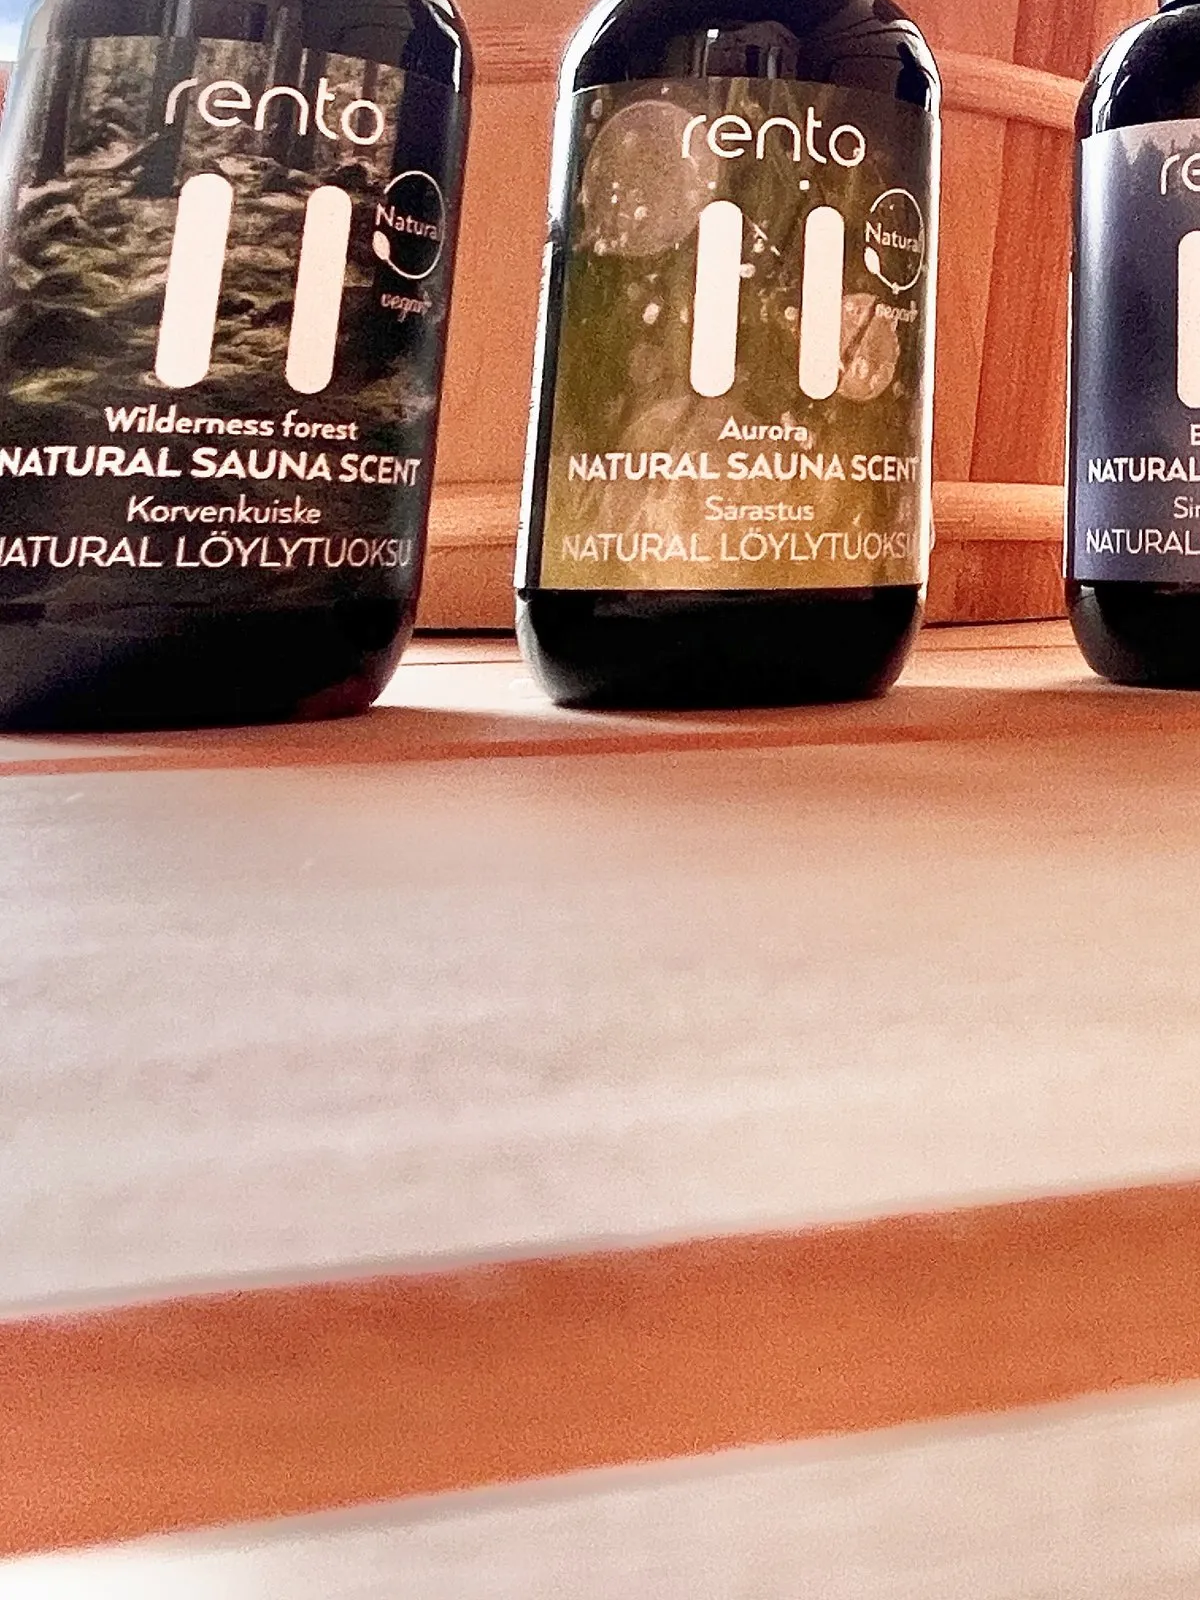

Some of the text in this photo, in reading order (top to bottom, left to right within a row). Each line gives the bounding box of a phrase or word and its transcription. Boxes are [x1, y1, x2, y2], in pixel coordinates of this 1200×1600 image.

[166, 77, 385, 146] rento
[682, 107, 867, 168] rento
[104, 404, 360, 441] Wilderness forest
[717, 415, 809, 442] Aurora
[0, 445, 422, 487] NATURAL SAUNA SCENT
[569, 452, 919, 483] NATURAL SAUNA SCENT
[127, 494, 322, 524] Korvenkuiske
[704, 495, 815, 521] Sarastus
[176, 530, 412, 568] LÖYLYTUOKSU
[562, 532, 711, 562] NATURAL
